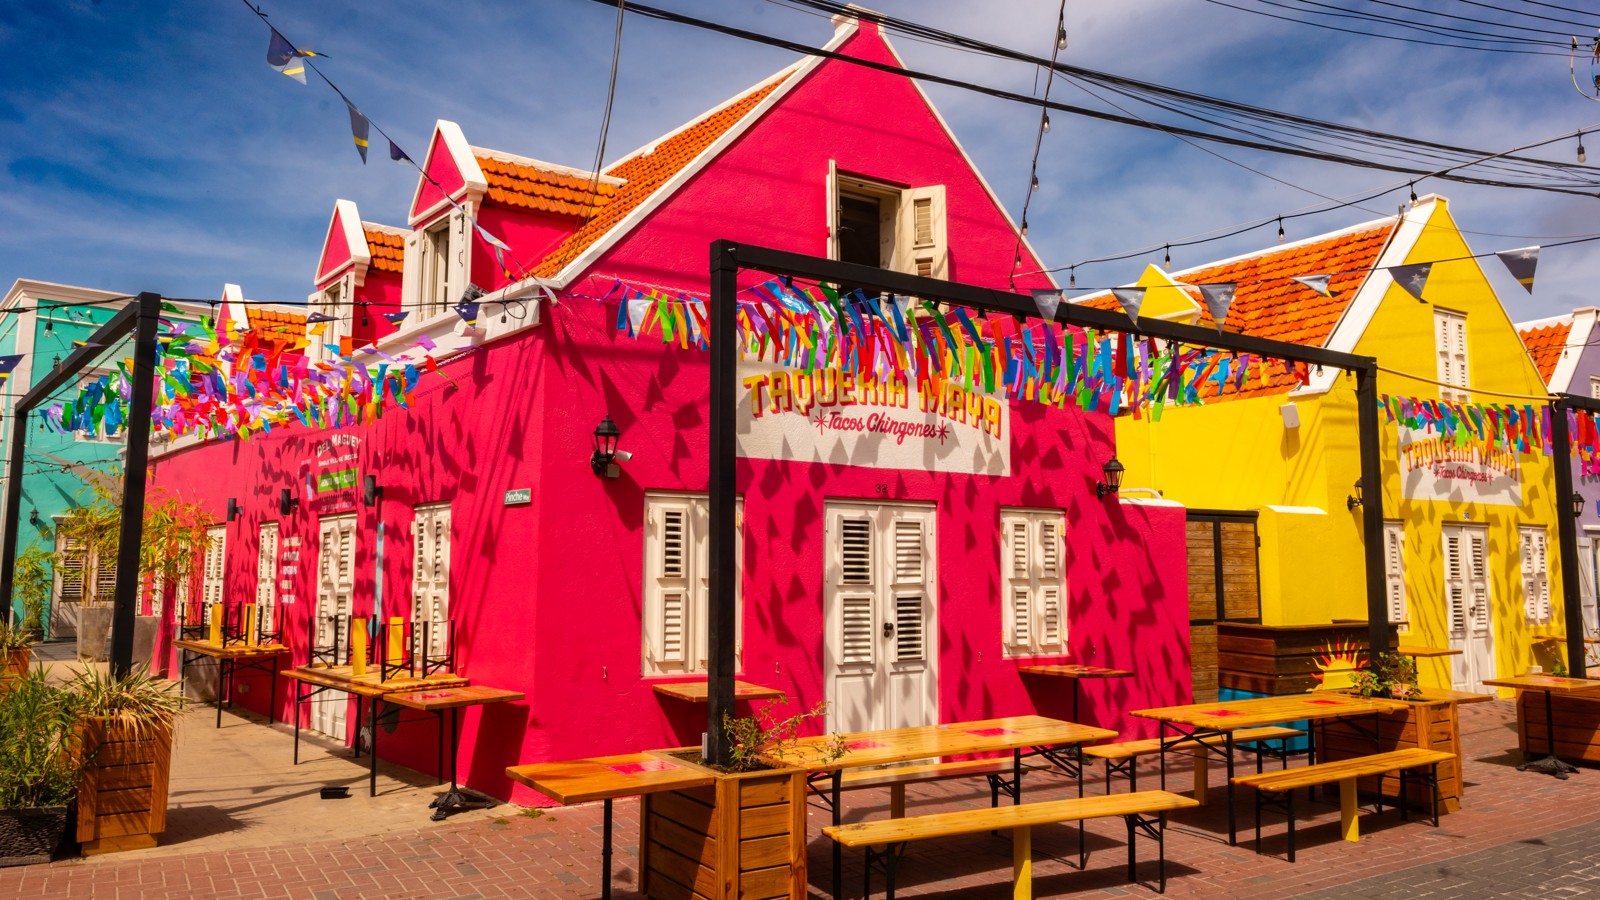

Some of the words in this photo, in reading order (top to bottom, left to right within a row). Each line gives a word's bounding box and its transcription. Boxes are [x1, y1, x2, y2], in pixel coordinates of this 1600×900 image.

[743, 366, 908, 418] TAQUERIA
[919, 379, 1001, 440] MAYA
[828, 411, 865, 432] Tacos
[866, 411, 936, 445] Chingones
[317, 440, 330, 458] DEL
[331, 433, 361, 448] MAGUEY
[1439, 466, 1455, 479] Tacos
[1456, 466, 1487, 487] Chingones
[505, 491, 522, 502] Pinche
[875, 483, 888, 494] 32
